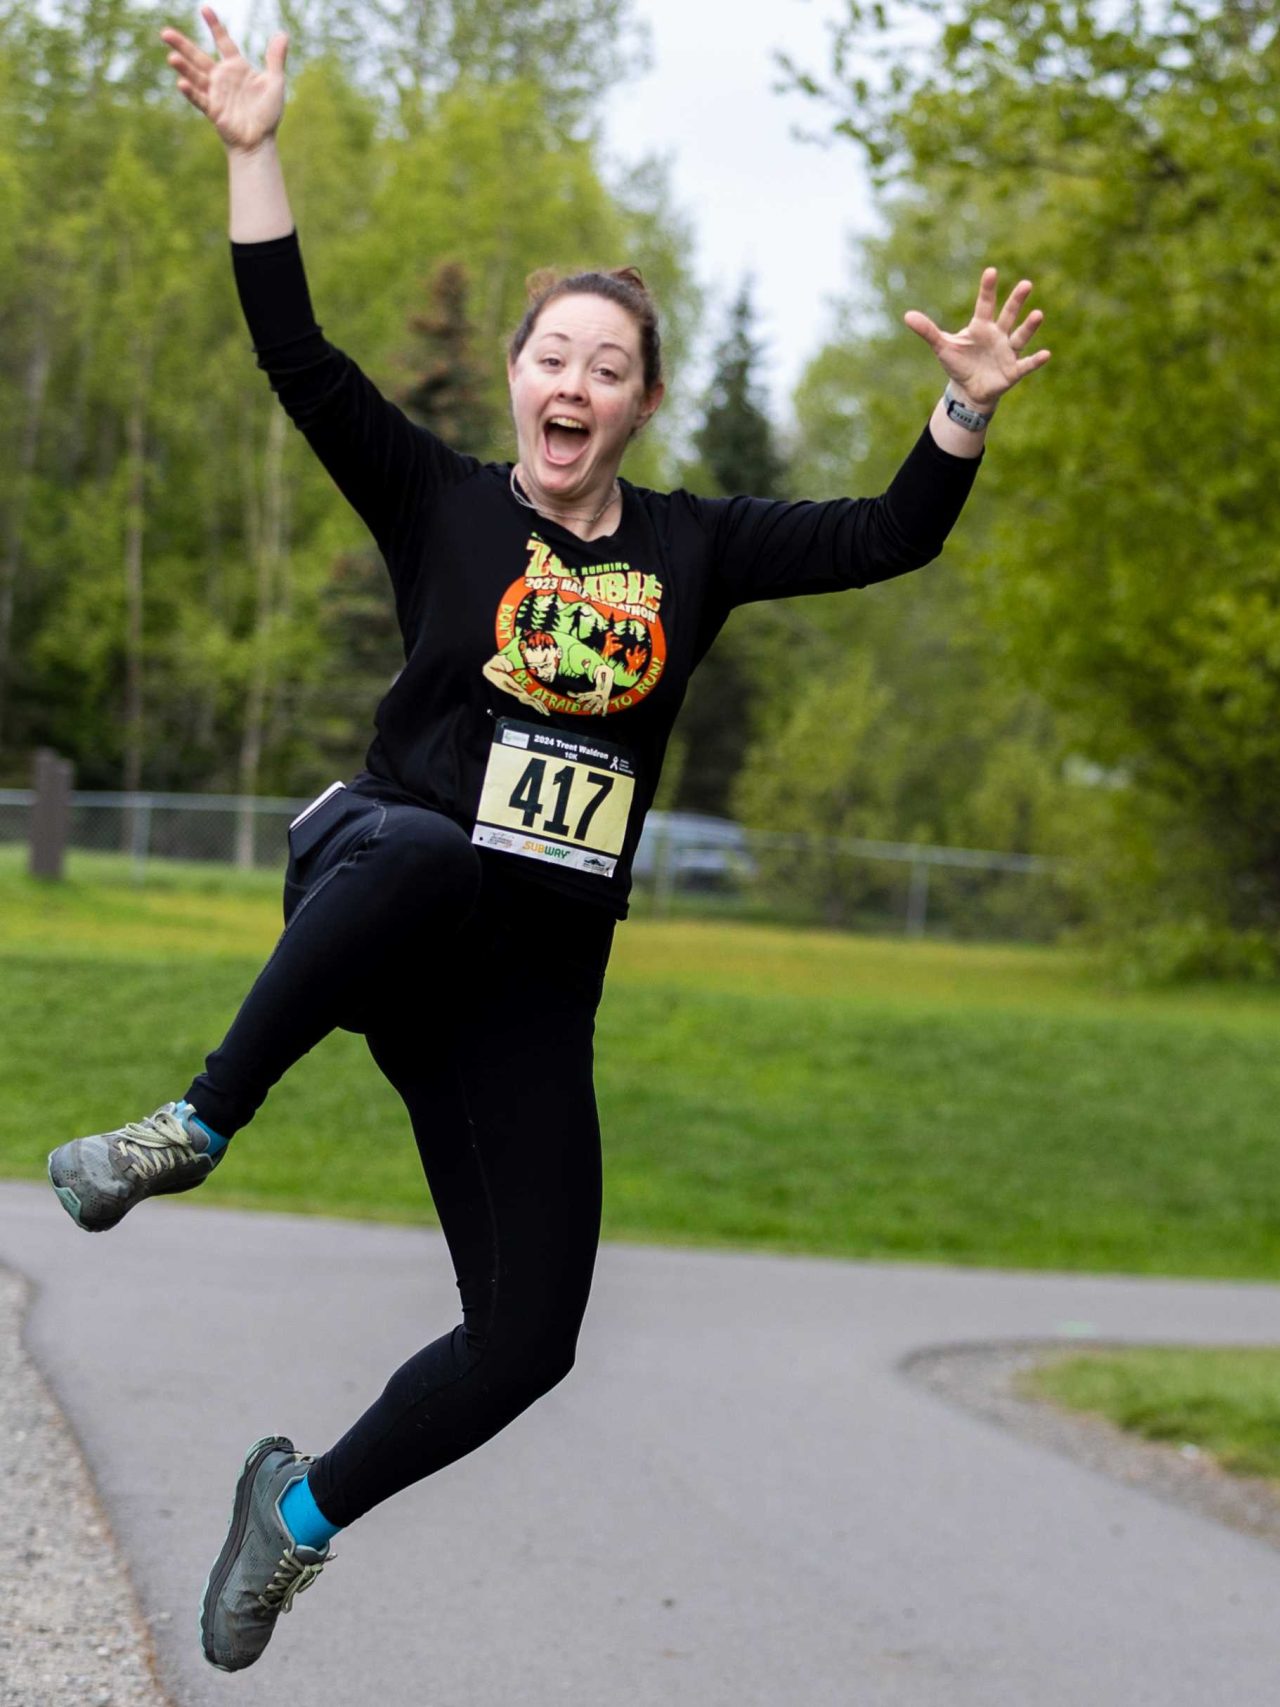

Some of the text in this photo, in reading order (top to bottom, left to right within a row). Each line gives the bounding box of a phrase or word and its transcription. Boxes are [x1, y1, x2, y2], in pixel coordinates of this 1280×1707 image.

[525, 578, 559, 590] 2023
[513, 657, 664, 713] BE AFRAID TO RUN!
[534, 734, 555, 747] 2024
[556, 740, 578, 752] Trent
[579, 745, 609, 760] Waldron
[565, 751, 578, 760] 10K
[508, 757, 615, 841] 417
[523, 841, 571, 859] SUBWAY
